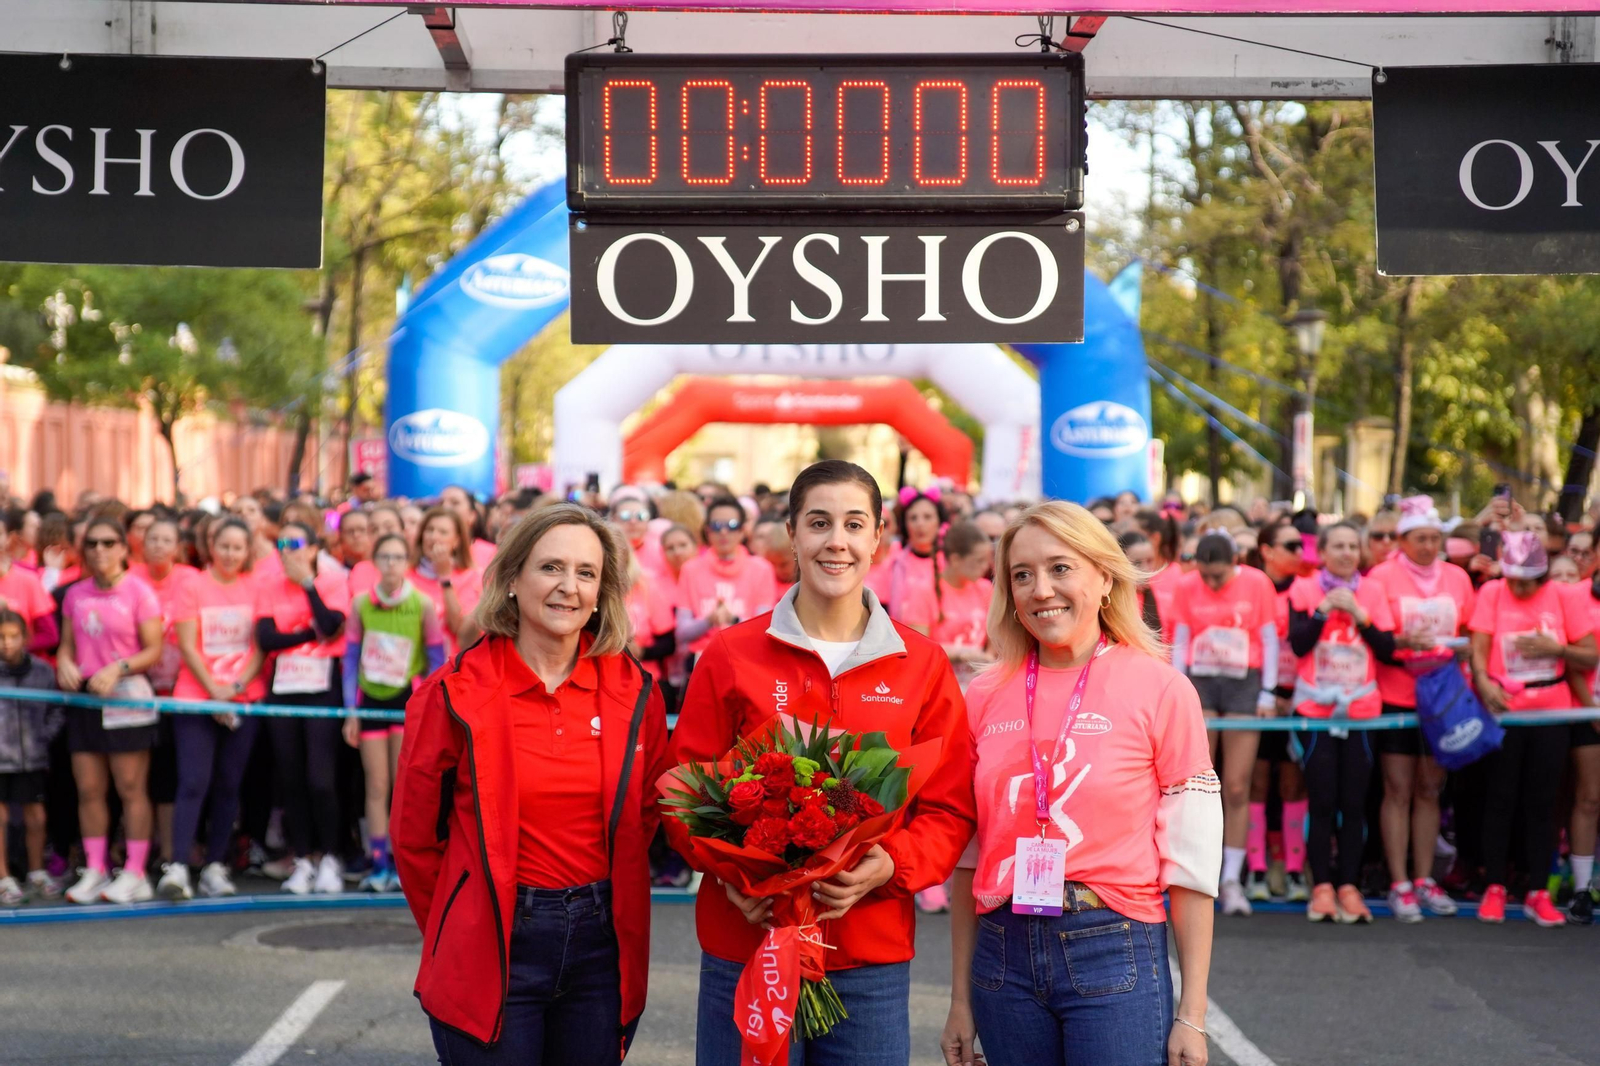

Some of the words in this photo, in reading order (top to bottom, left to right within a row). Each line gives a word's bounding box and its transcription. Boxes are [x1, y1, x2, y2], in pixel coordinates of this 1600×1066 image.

[1458, 139, 1600, 211] OY
[596, 231, 1059, 327] OYSHO
[861, 693, 904, 705] Santander
[983, 718, 1025, 737] OYSHO
